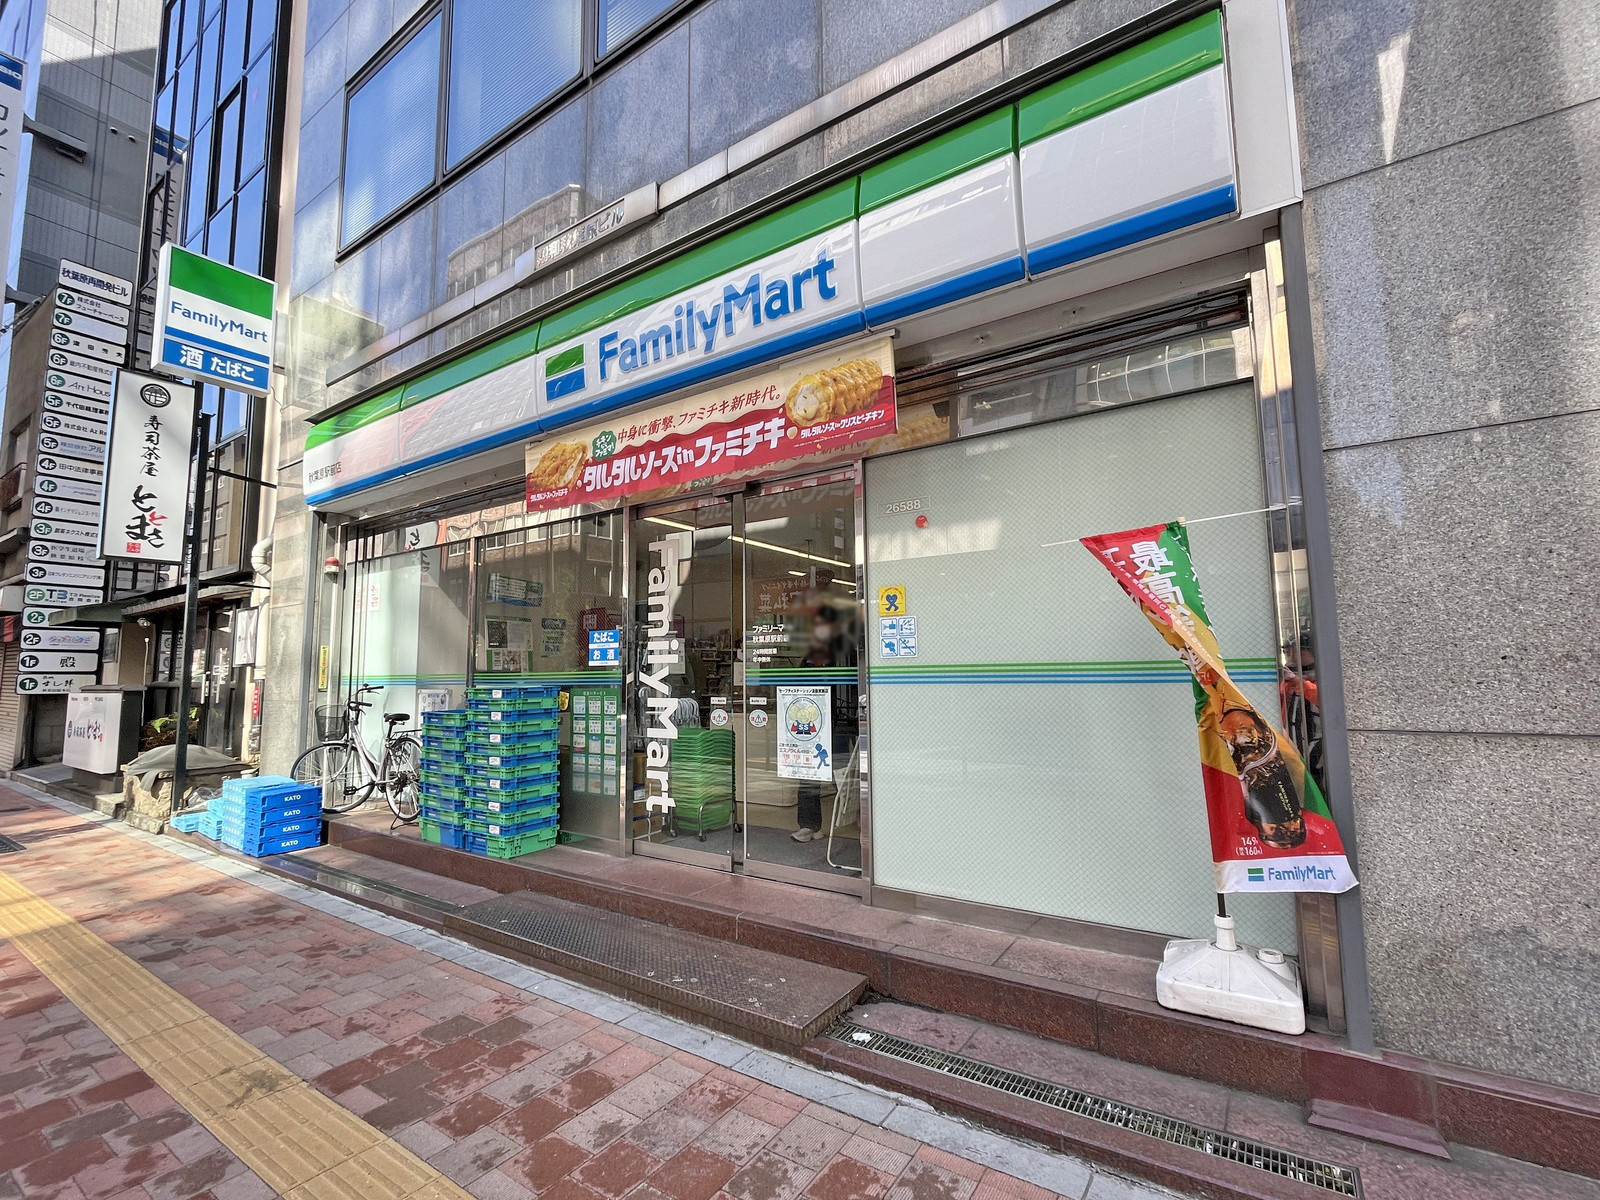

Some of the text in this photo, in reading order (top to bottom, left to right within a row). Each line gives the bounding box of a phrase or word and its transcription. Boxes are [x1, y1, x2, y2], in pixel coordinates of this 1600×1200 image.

[61, 267, 129, 297] 秋葉原再開発ビル
[60, 293, 73, 305] 7F
[58, 313, 71, 325] 7F
[599, 248, 837, 381] FamilyMart
[170, 300, 268, 343] FamilyMart
[55, 334, 69, 345] 6F
[52, 354, 66, 366] 6F
[179, 345, 255, 382] 酒 たばこ
[50, 375, 63, 386] 6F
[68, 381, 85, 392] Art
[47, 395, 61, 406] 5F
[617, 384, 781, 444] 中身に衝撃、ファミチキ新時代。
[45, 416, 60, 428] 5F
[43, 437, 58, 449] 5F
[140, 414, 164, 477] 寿司茶屋
[583, 416, 786, 493] タルタルソースinファミチキ
[40, 459, 56, 470] 4F
[41, 480, 55, 492] 4F
[36, 502, 52, 513] 4F
[886, 499, 921, 514] 26588
[36, 523, 51, 535] 3F
[33, 545, 48, 557] 3F
[31, 568, 46, 579] 3F
[28, 590, 45, 600] 2F
[46, 588, 68, 600] T3
[30, 612, 44, 623] 2F
[752, 624, 788, 634] ファミリーマ
[25, 634, 40, 645] 2F
[593, 631, 615, 643] たばこ
[593, 649, 615, 660] お酒
[23, 656, 37, 667] 1F
[640, 538, 680, 815] FamilyMart
[22, 679, 36, 690] 1F
[284, 794, 301, 802] KATO
[283, 809, 301, 817] KATO
[281, 840, 298, 848] KATO
[1268, 865, 1337, 883] FamilyMart
